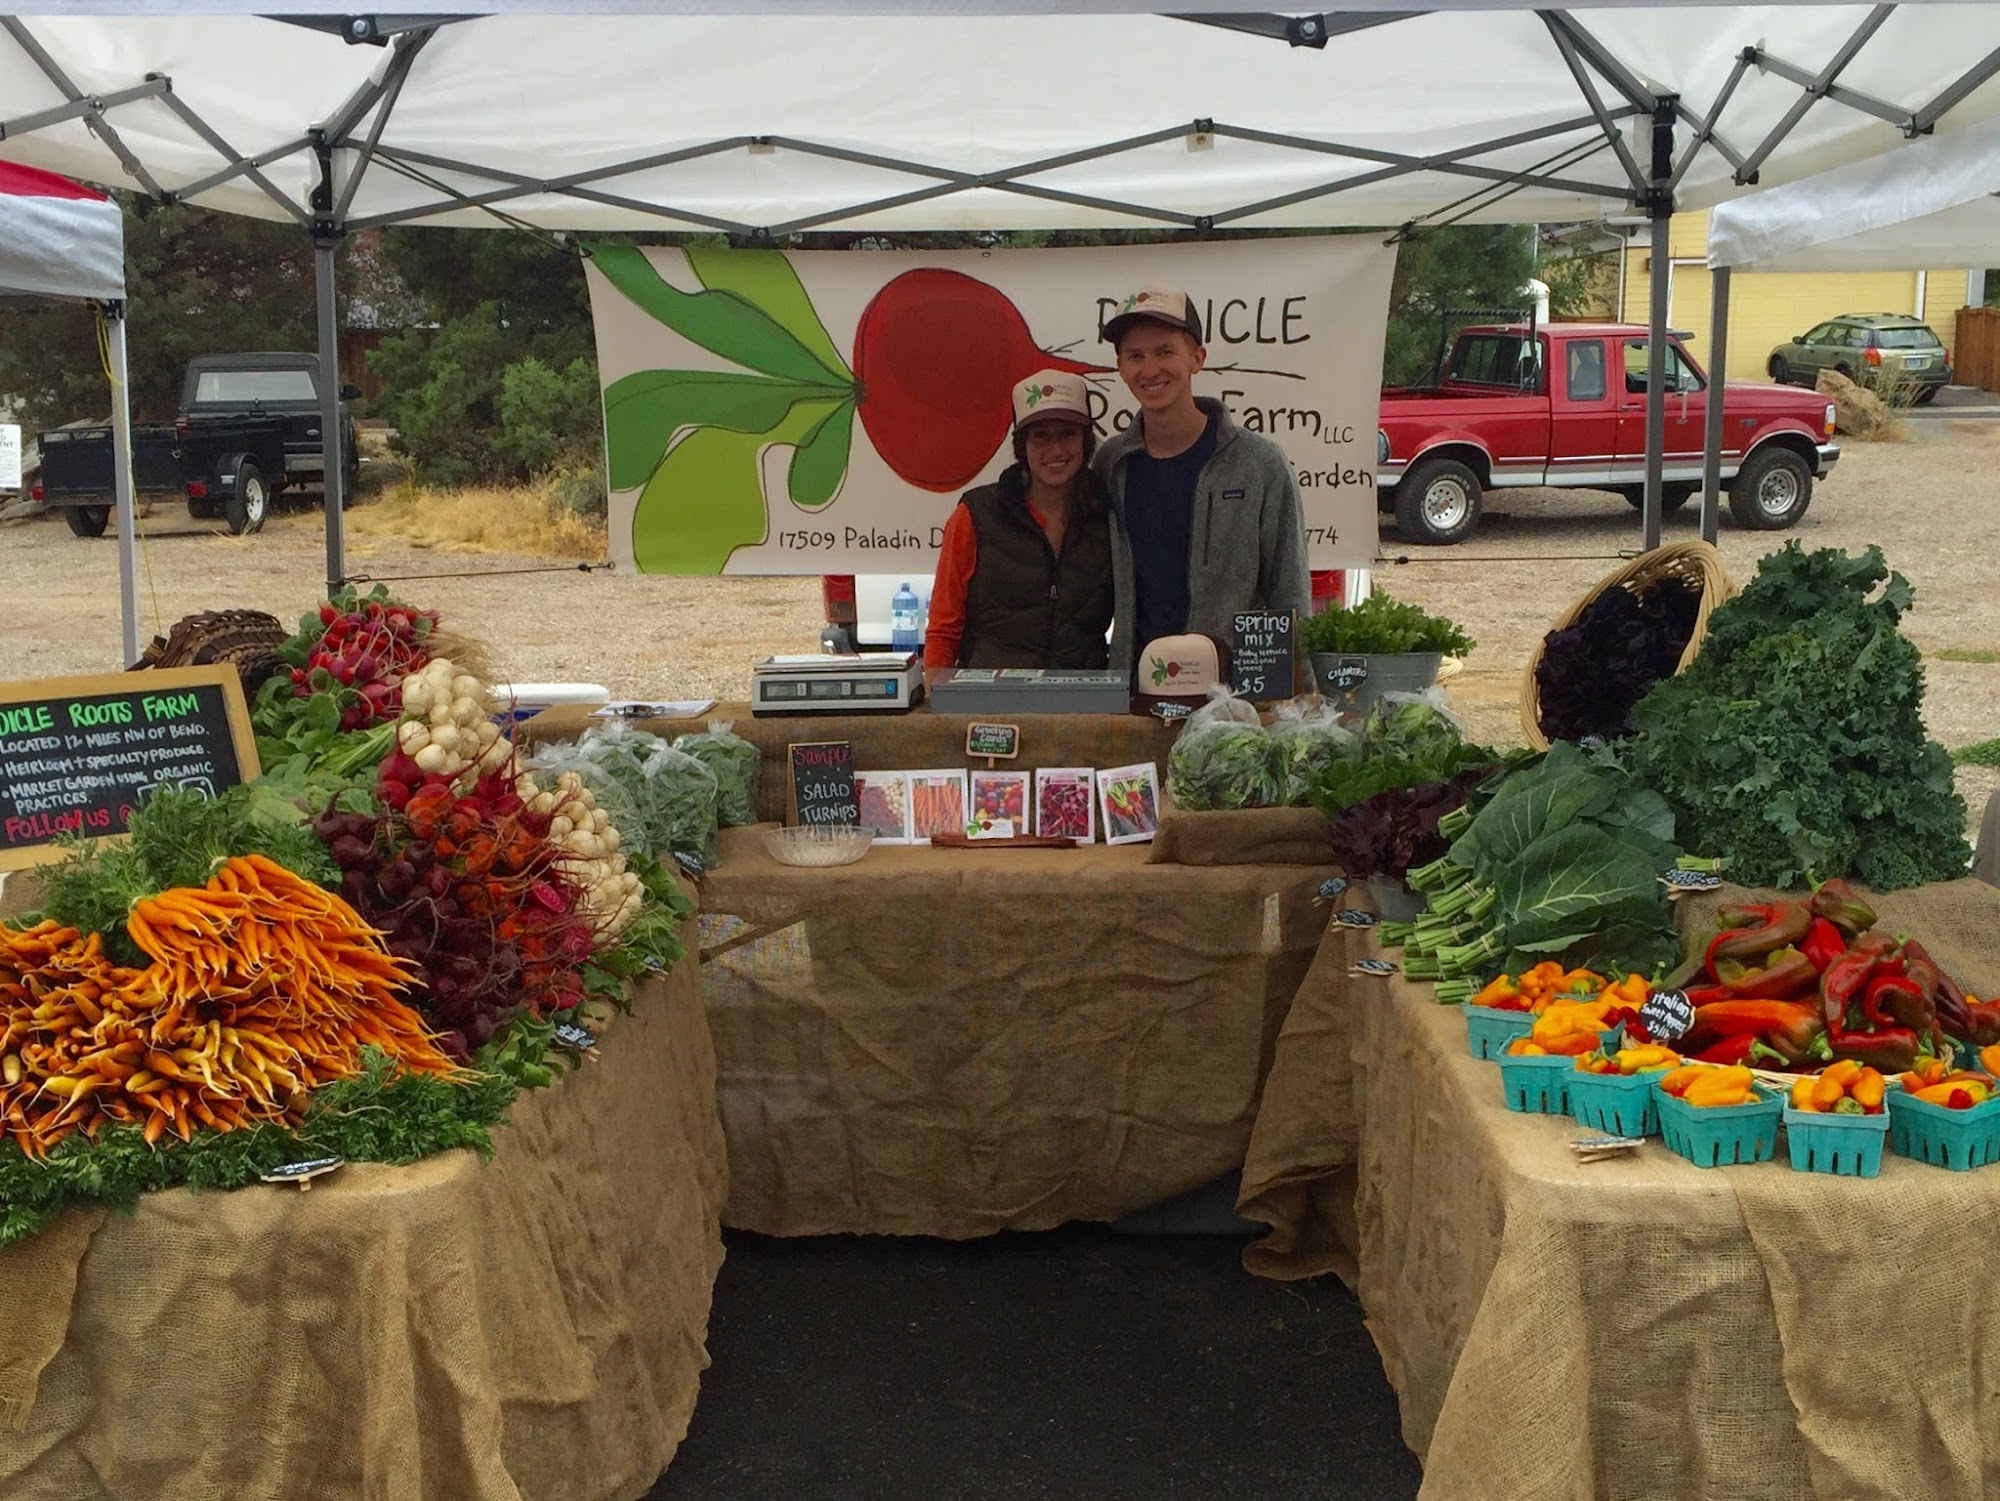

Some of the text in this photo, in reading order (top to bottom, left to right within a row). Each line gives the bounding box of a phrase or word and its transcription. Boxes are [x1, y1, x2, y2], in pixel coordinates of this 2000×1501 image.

[1323, 425, 1355, 444] LLC
[1290, 460, 1373, 489] arden
[779, 530, 835, 550] 17509
[844, 525, 921, 550] Paladin
[1234, 611, 1290, 634] Spring
[1244, 630, 1274, 647] mix
[1238, 648, 1289, 658] Baby lettuce
[1242, 657, 1277, 666] seasonal
[1237, 666, 1264, 675] greens
[1327, 666, 1368, 681] CILANTRO
[1338, 676, 1354, 687] $2
[1241, 675, 1266, 694] $5
[0, 692, 200, 737] DICLE ROOTS FARM
[0, 722, 211, 755] LOCATED 12 MILES NW OF BEND.
[4, 758, 74, 778] HEIRLOOM
[86, 750, 149, 769] SPECIALTY
[9, 761, 215, 800] MARKET GARDEN USING ORGANIC
[803, 782, 851, 801] SALAD
[15, 791, 93, 816] PRACTICES.
[5, 809, 83, 842] FOLLOW
[86, 808, 111, 827] US
[1651, 992, 1690, 1019] Italian
